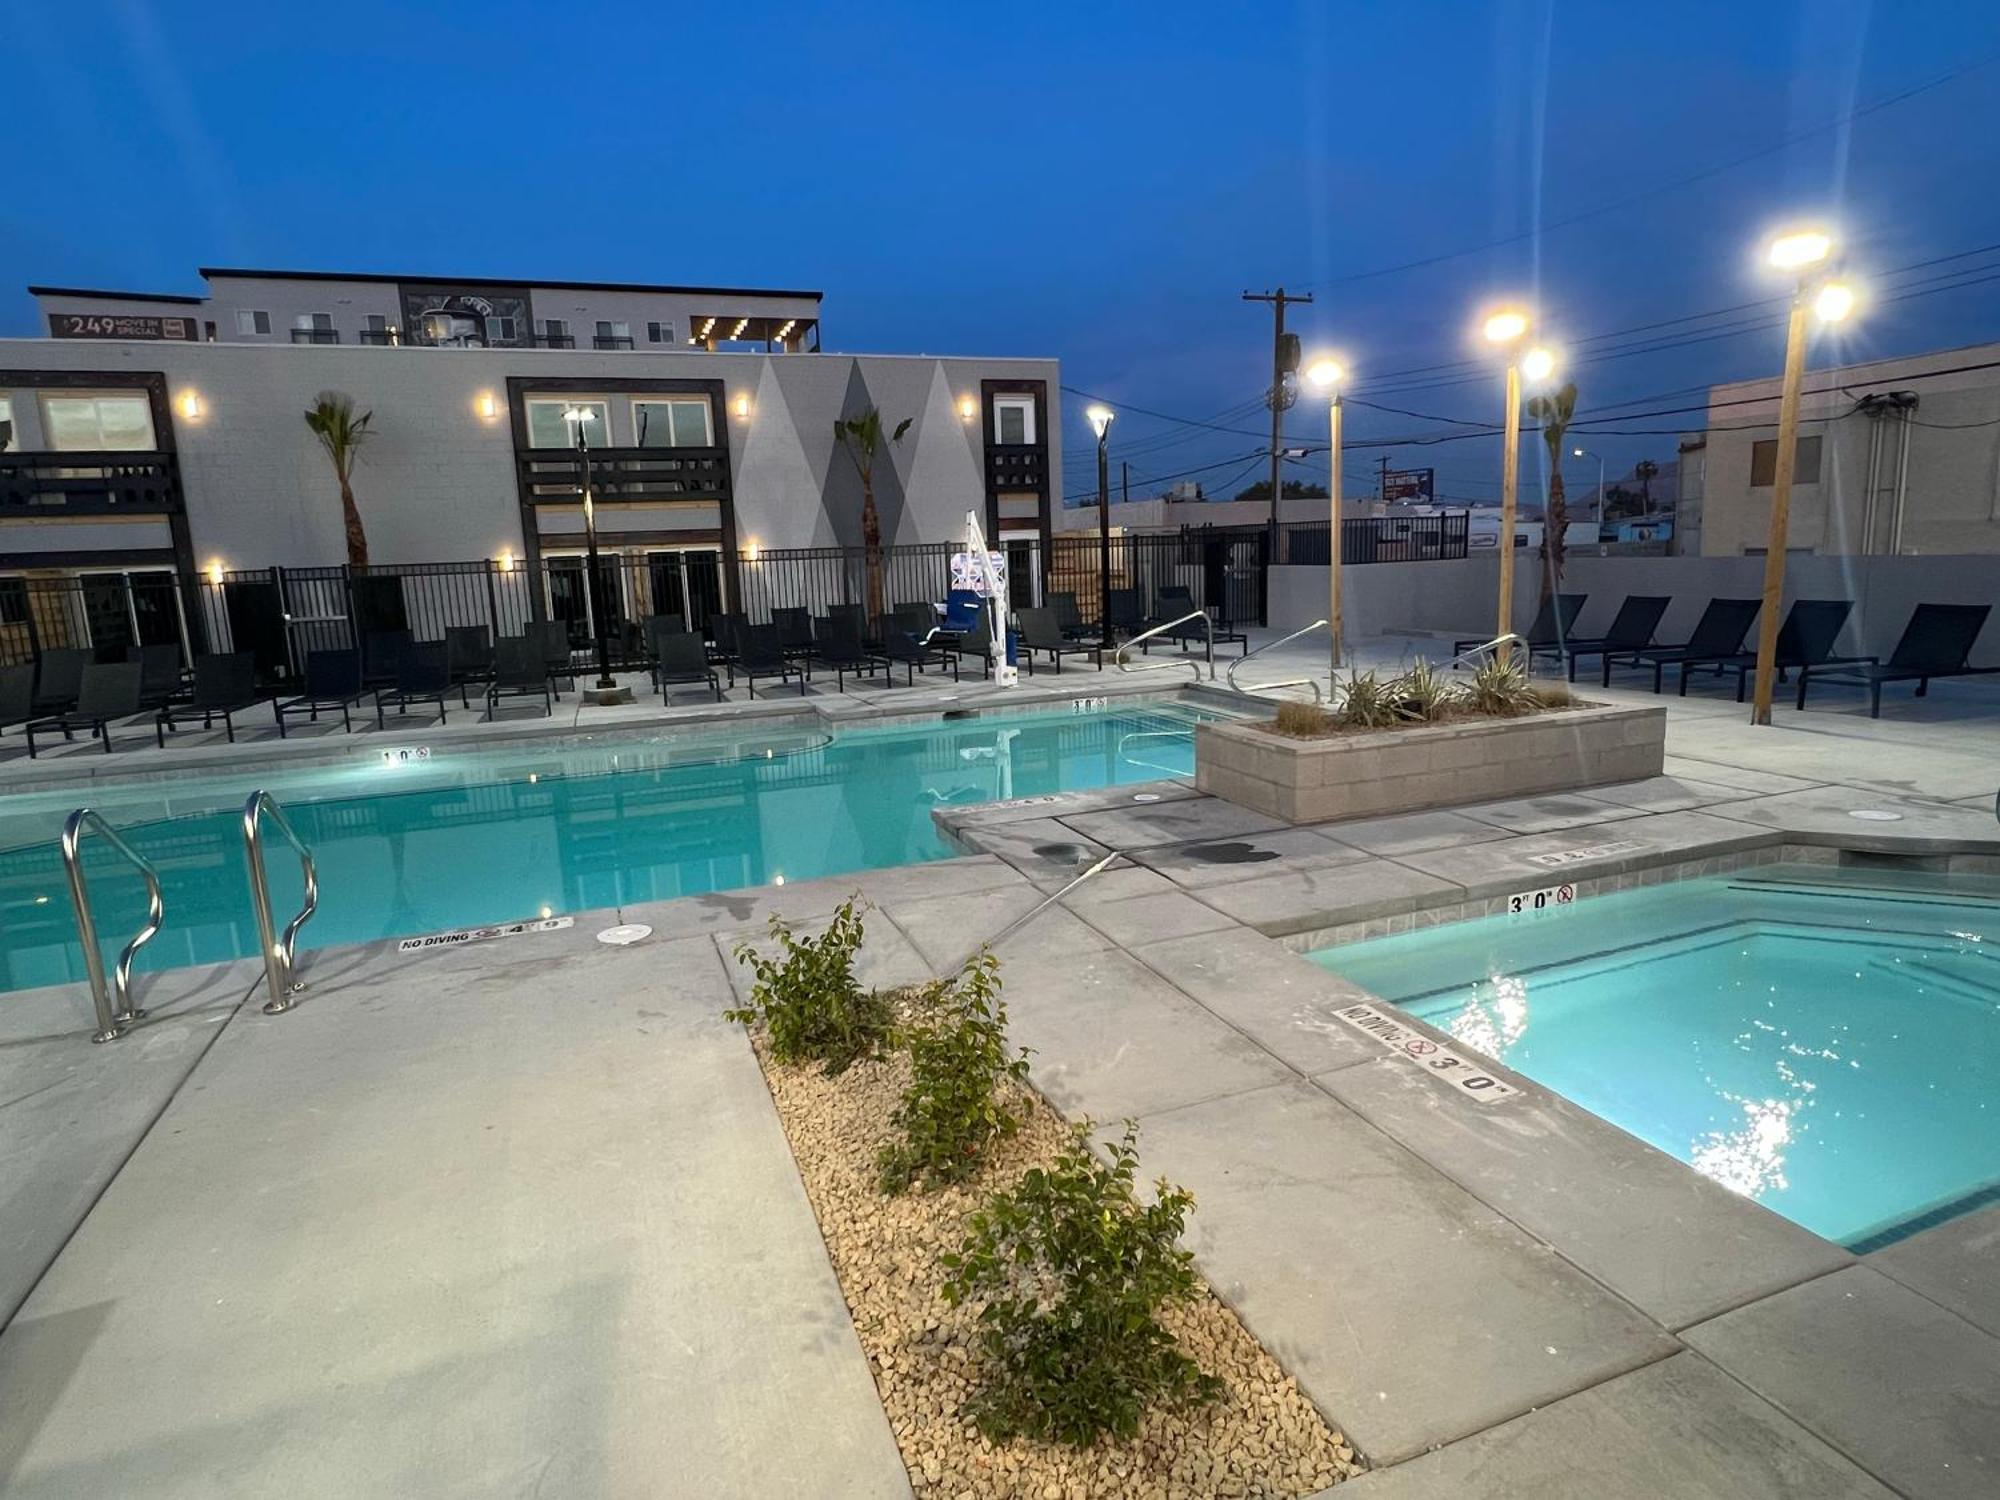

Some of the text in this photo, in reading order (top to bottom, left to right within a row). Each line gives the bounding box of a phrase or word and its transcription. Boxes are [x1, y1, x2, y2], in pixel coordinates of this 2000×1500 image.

[117, 327, 158, 335] SPECIAL
[1511, 897, 1522, 912] 3
[1535, 892, 1546, 908] 0
[402, 939, 422, 949] NO
[425, 933, 469, 946] DIVING
[1357, 1012, 1410, 1041] DIVING
[1429, 1057, 1460, 1070] 3
[1462, 1076, 1495, 1090] 0
